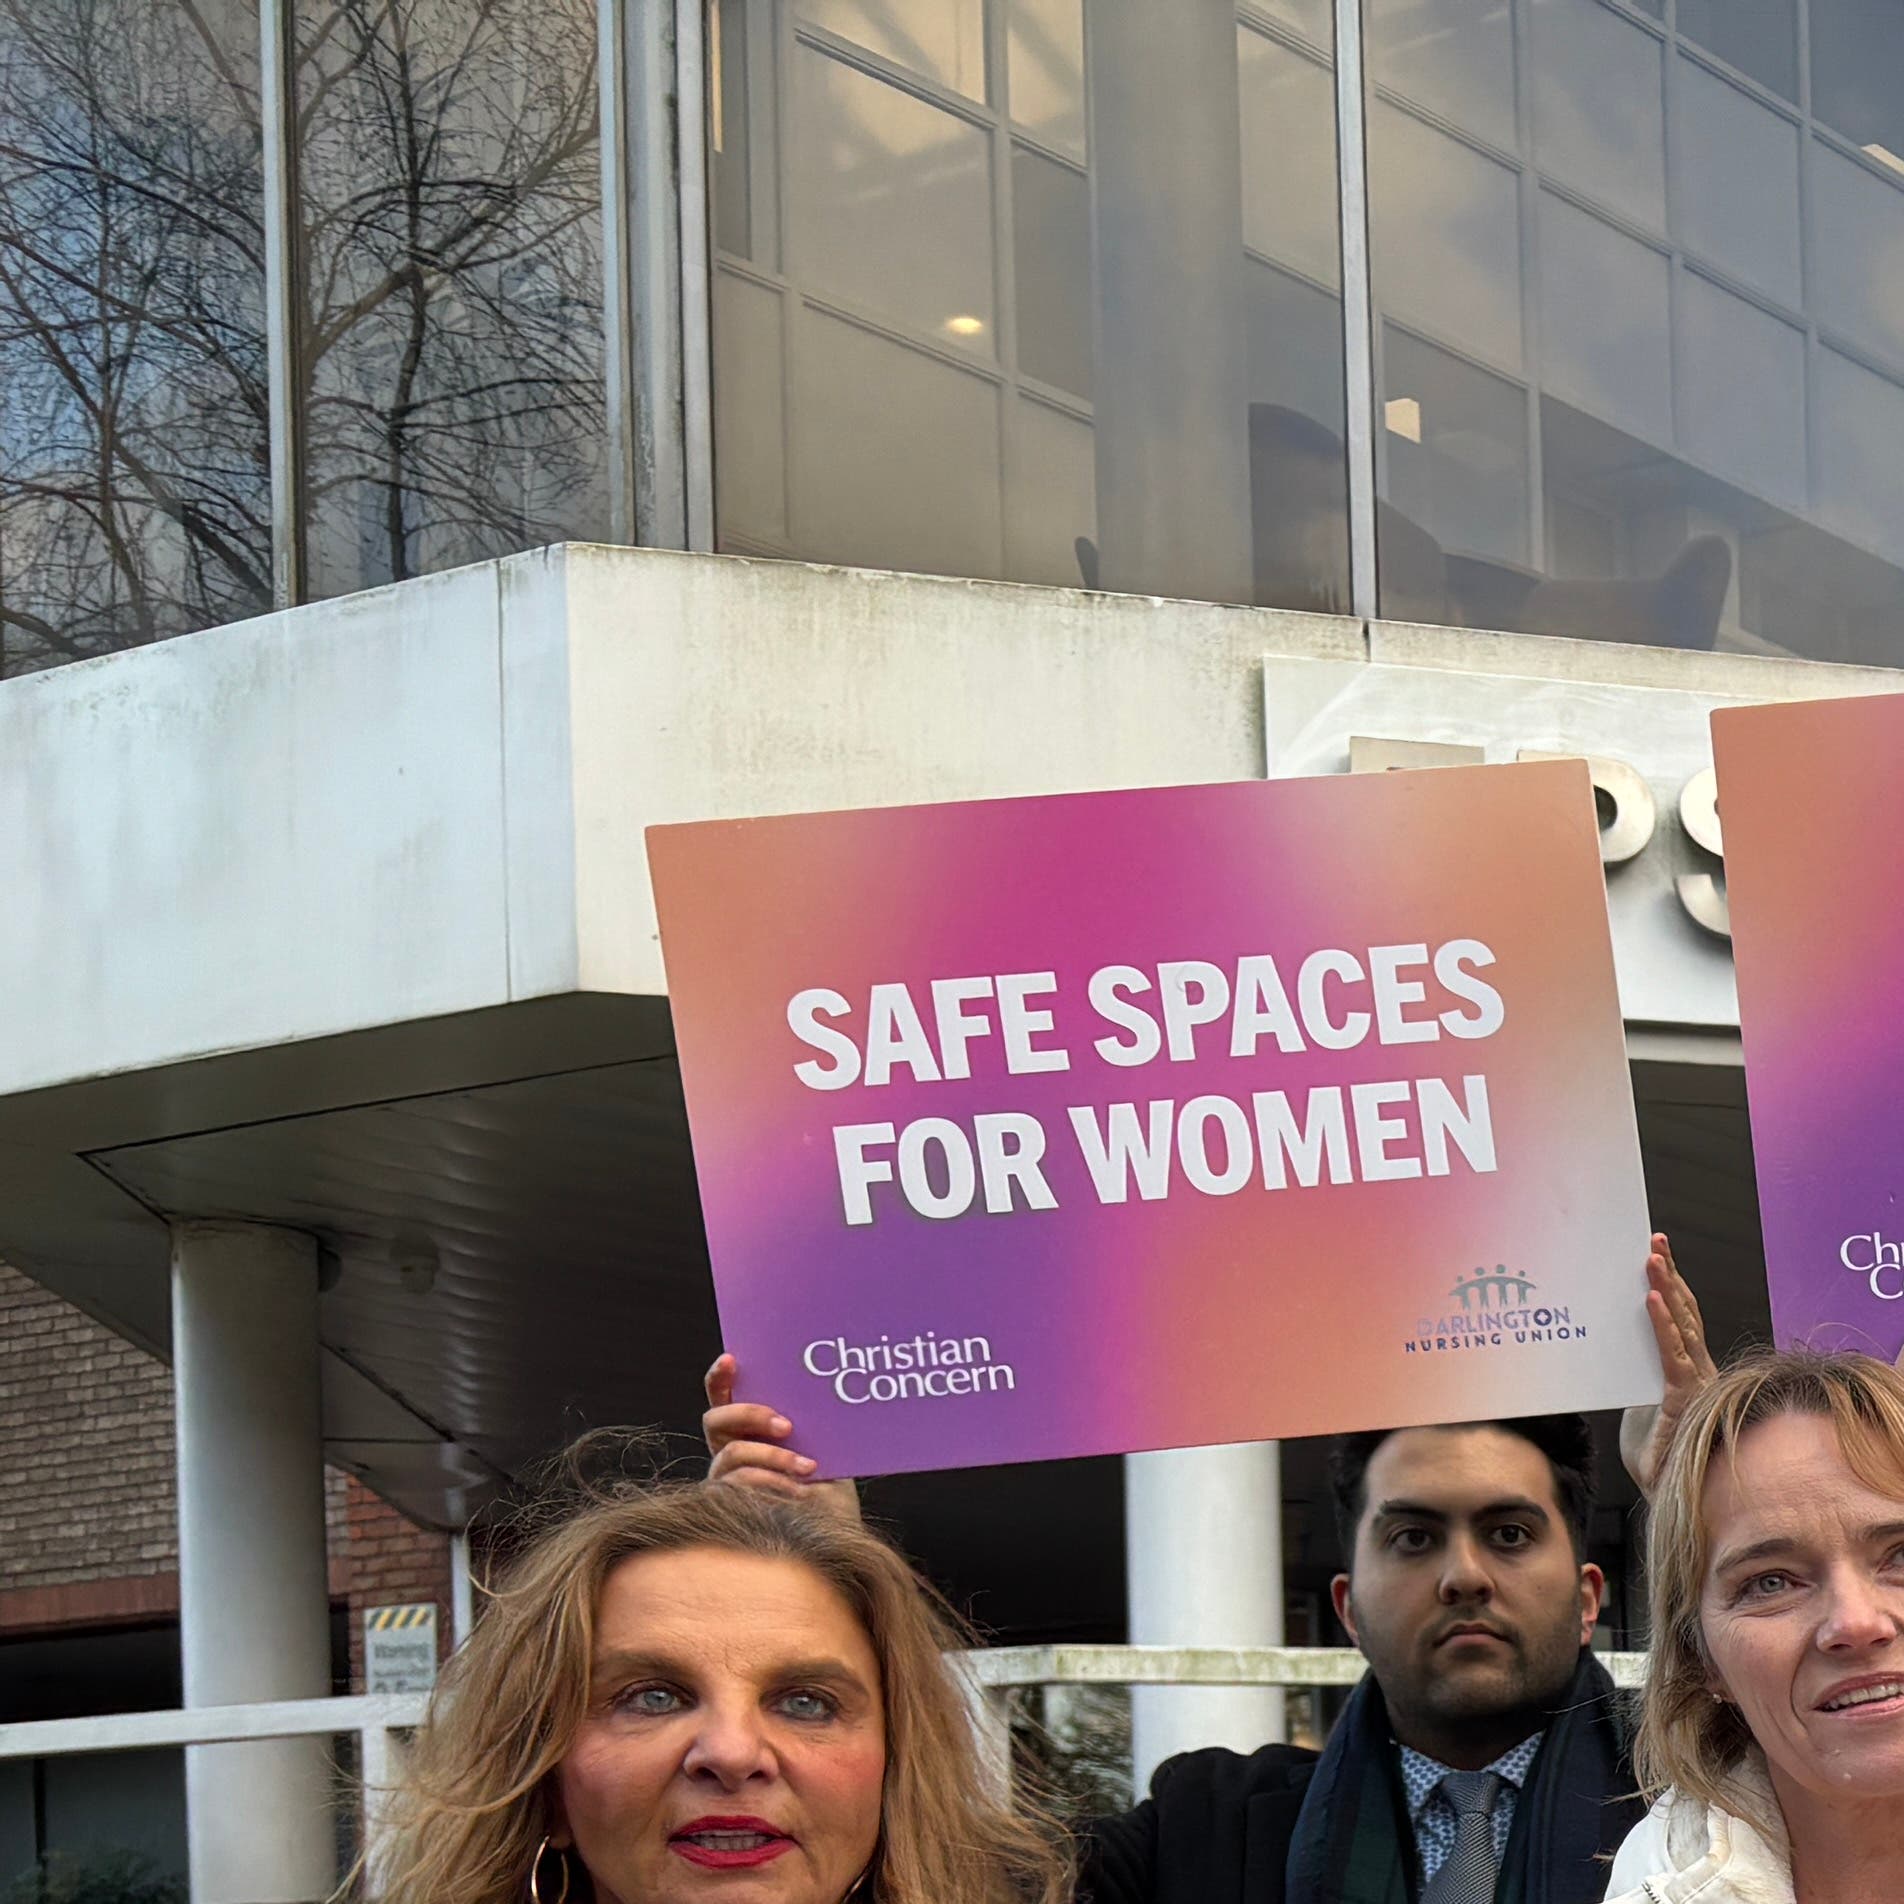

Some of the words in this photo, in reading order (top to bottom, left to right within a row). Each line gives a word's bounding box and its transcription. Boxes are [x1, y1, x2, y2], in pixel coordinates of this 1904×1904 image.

[786, 971, 1071, 1091] SAFE
[1088, 938, 1505, 1067] SPACES
[832, 1112, 1059, 1225] FOR
[1067, 1074, 1499, 1204] WOMEN
[1405, 1333, 1502, 1353] NURSING
[1515, 1326, 1588, 1344] UNION
[1416, 1306, 1571, 1337] DARLINGTON
[804, 1331, 992, 1376] Christian
[834, 1364, 1015, 1404] Concern
